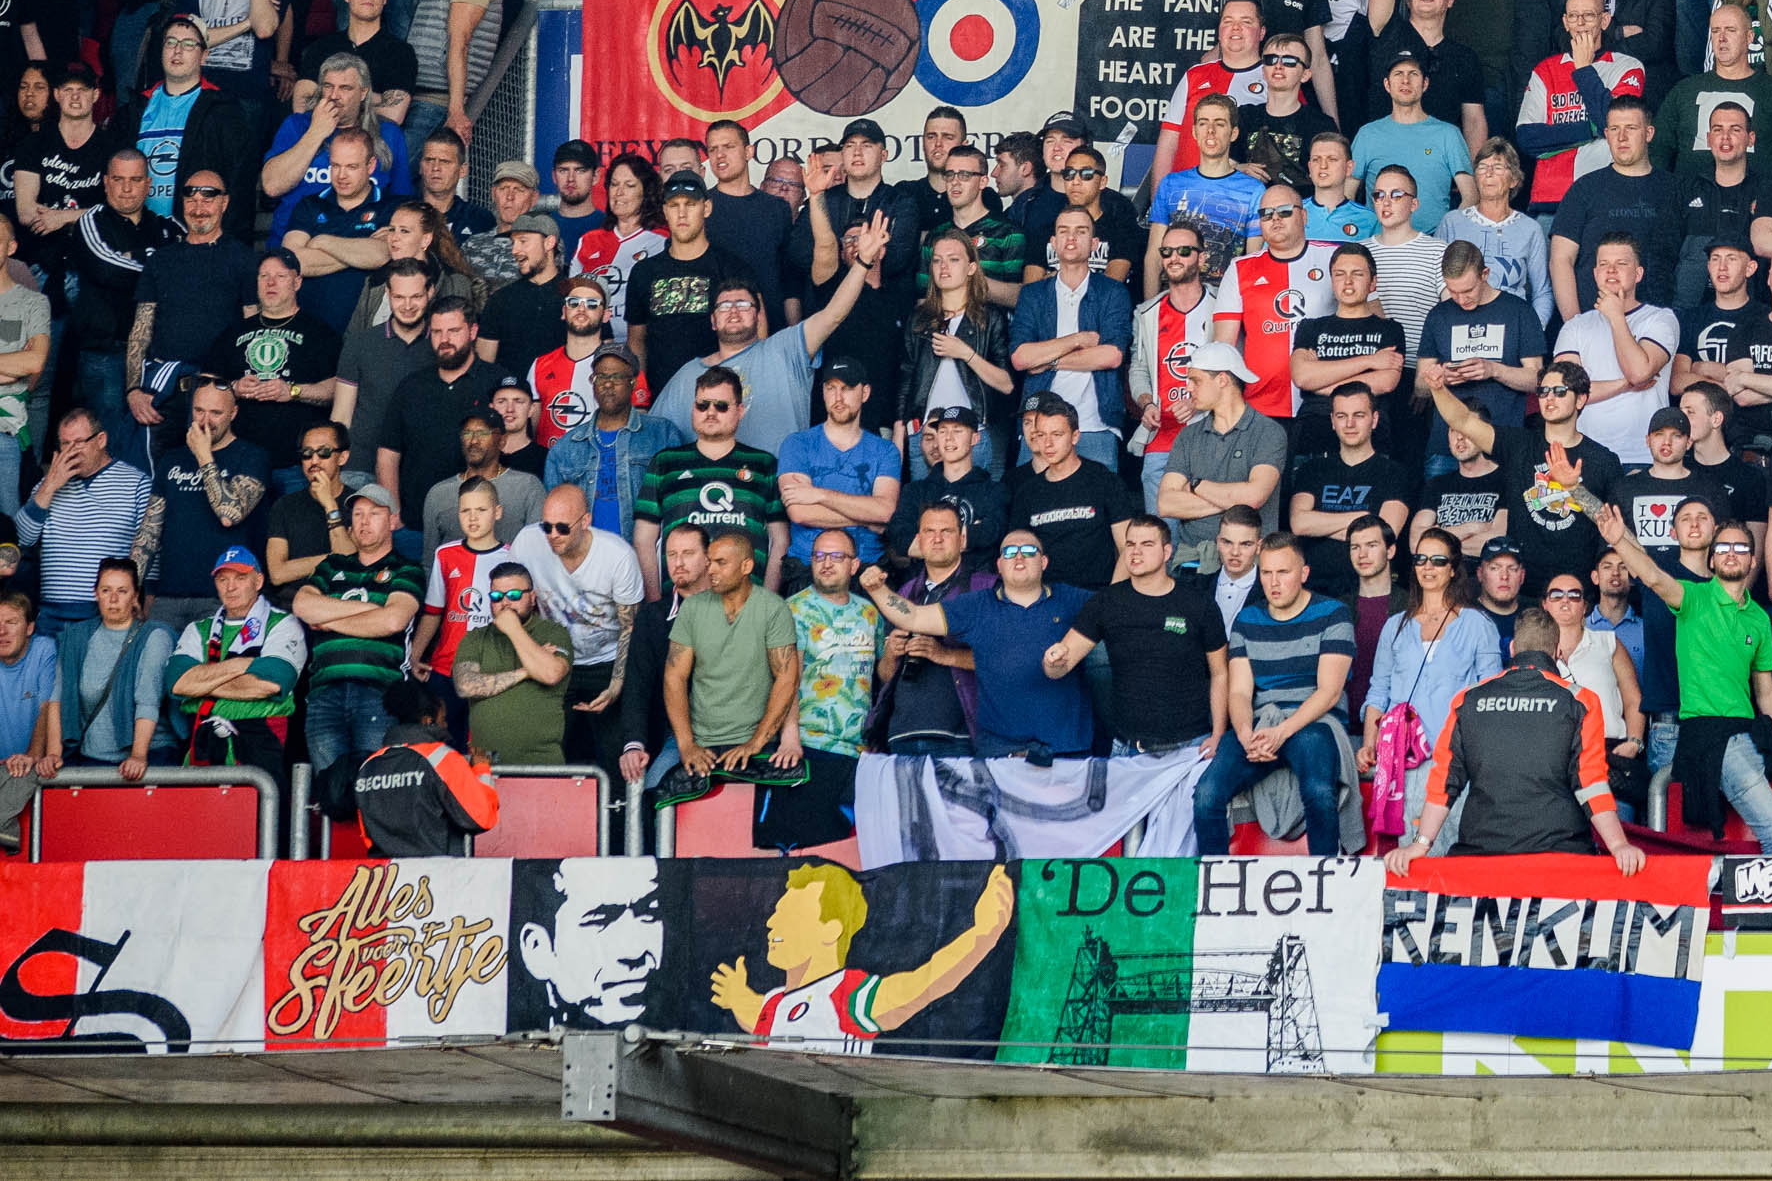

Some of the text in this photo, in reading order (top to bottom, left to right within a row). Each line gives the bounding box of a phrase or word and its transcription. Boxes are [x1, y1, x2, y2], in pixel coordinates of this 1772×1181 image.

[1109, 26, 1215, 50] ARE THE
[1098, 62, 1176, 86] HEART
[1089, 96, 1171, 121] FOOTB
[148, 185, 174, 198] OPE
[255, 329, 304, 346] CASUALS
[1263, 320, 1297, 334] Qurr
[1317, 332, 1362, 345] Groeten
[1321, 485, 1372, 505] EA7
[688, 511, 747, 527] Qurrent
[1476, 697, 1558, 713] SECURITY
[356, 771, 425, 793] SECURITY
[300, 863, 435, 946] Alles
[1384, 890, 1697, 979] RENKUM
[360, 938, 410, 964] voor
[268, 917, 508, 1040] Sfeertje
